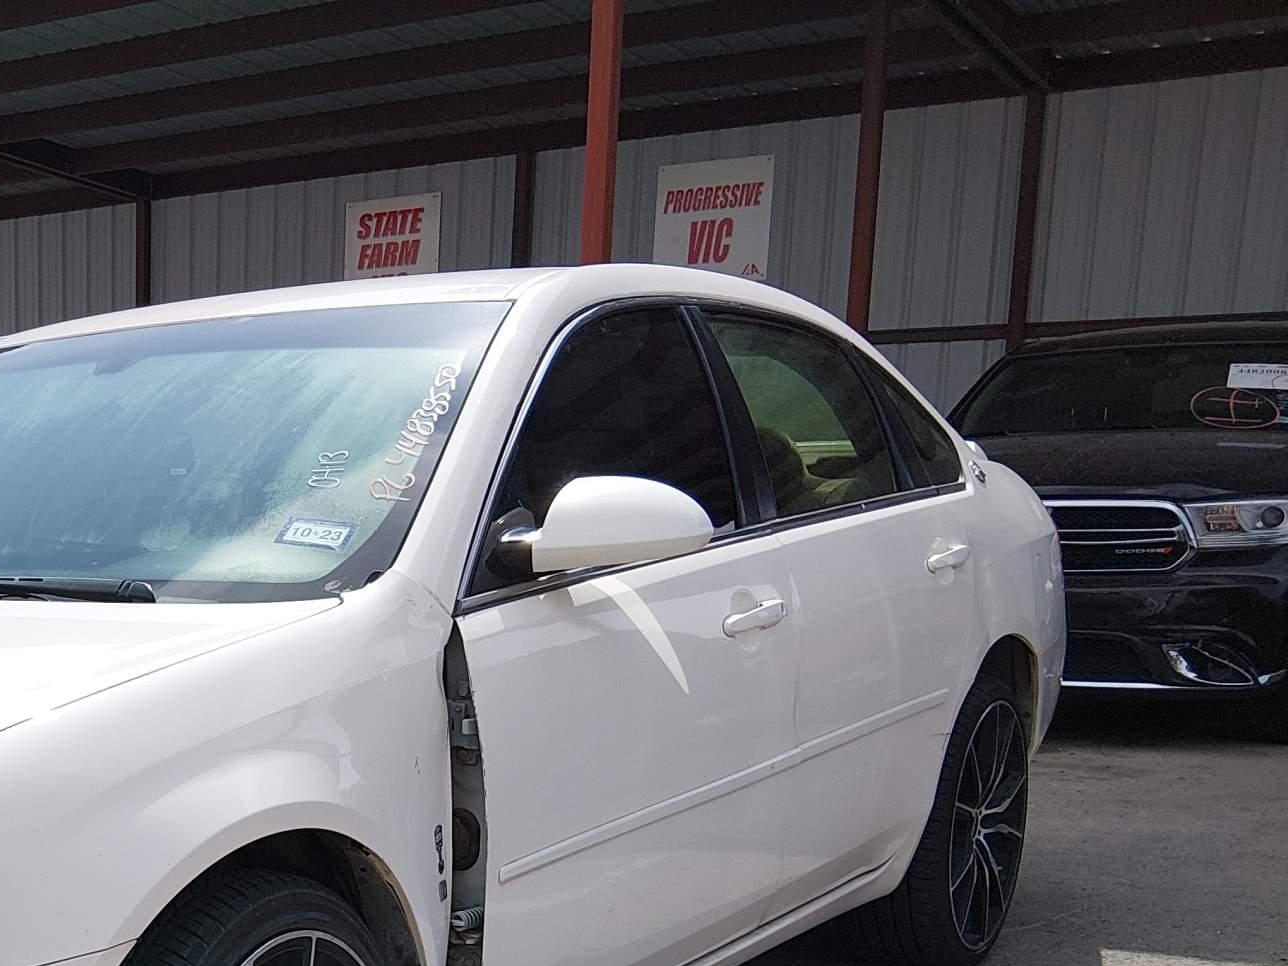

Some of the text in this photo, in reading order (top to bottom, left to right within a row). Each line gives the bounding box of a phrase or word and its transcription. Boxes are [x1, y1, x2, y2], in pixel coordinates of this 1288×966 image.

[663, 181, 765, 216] PROGRESSIVE
[357, 207, 425, 240] STATE
[357, 239, 421, 270] FARM
[686, 217, 734, 265] VIC
[1115, 547, 1162, 555] DODGE
